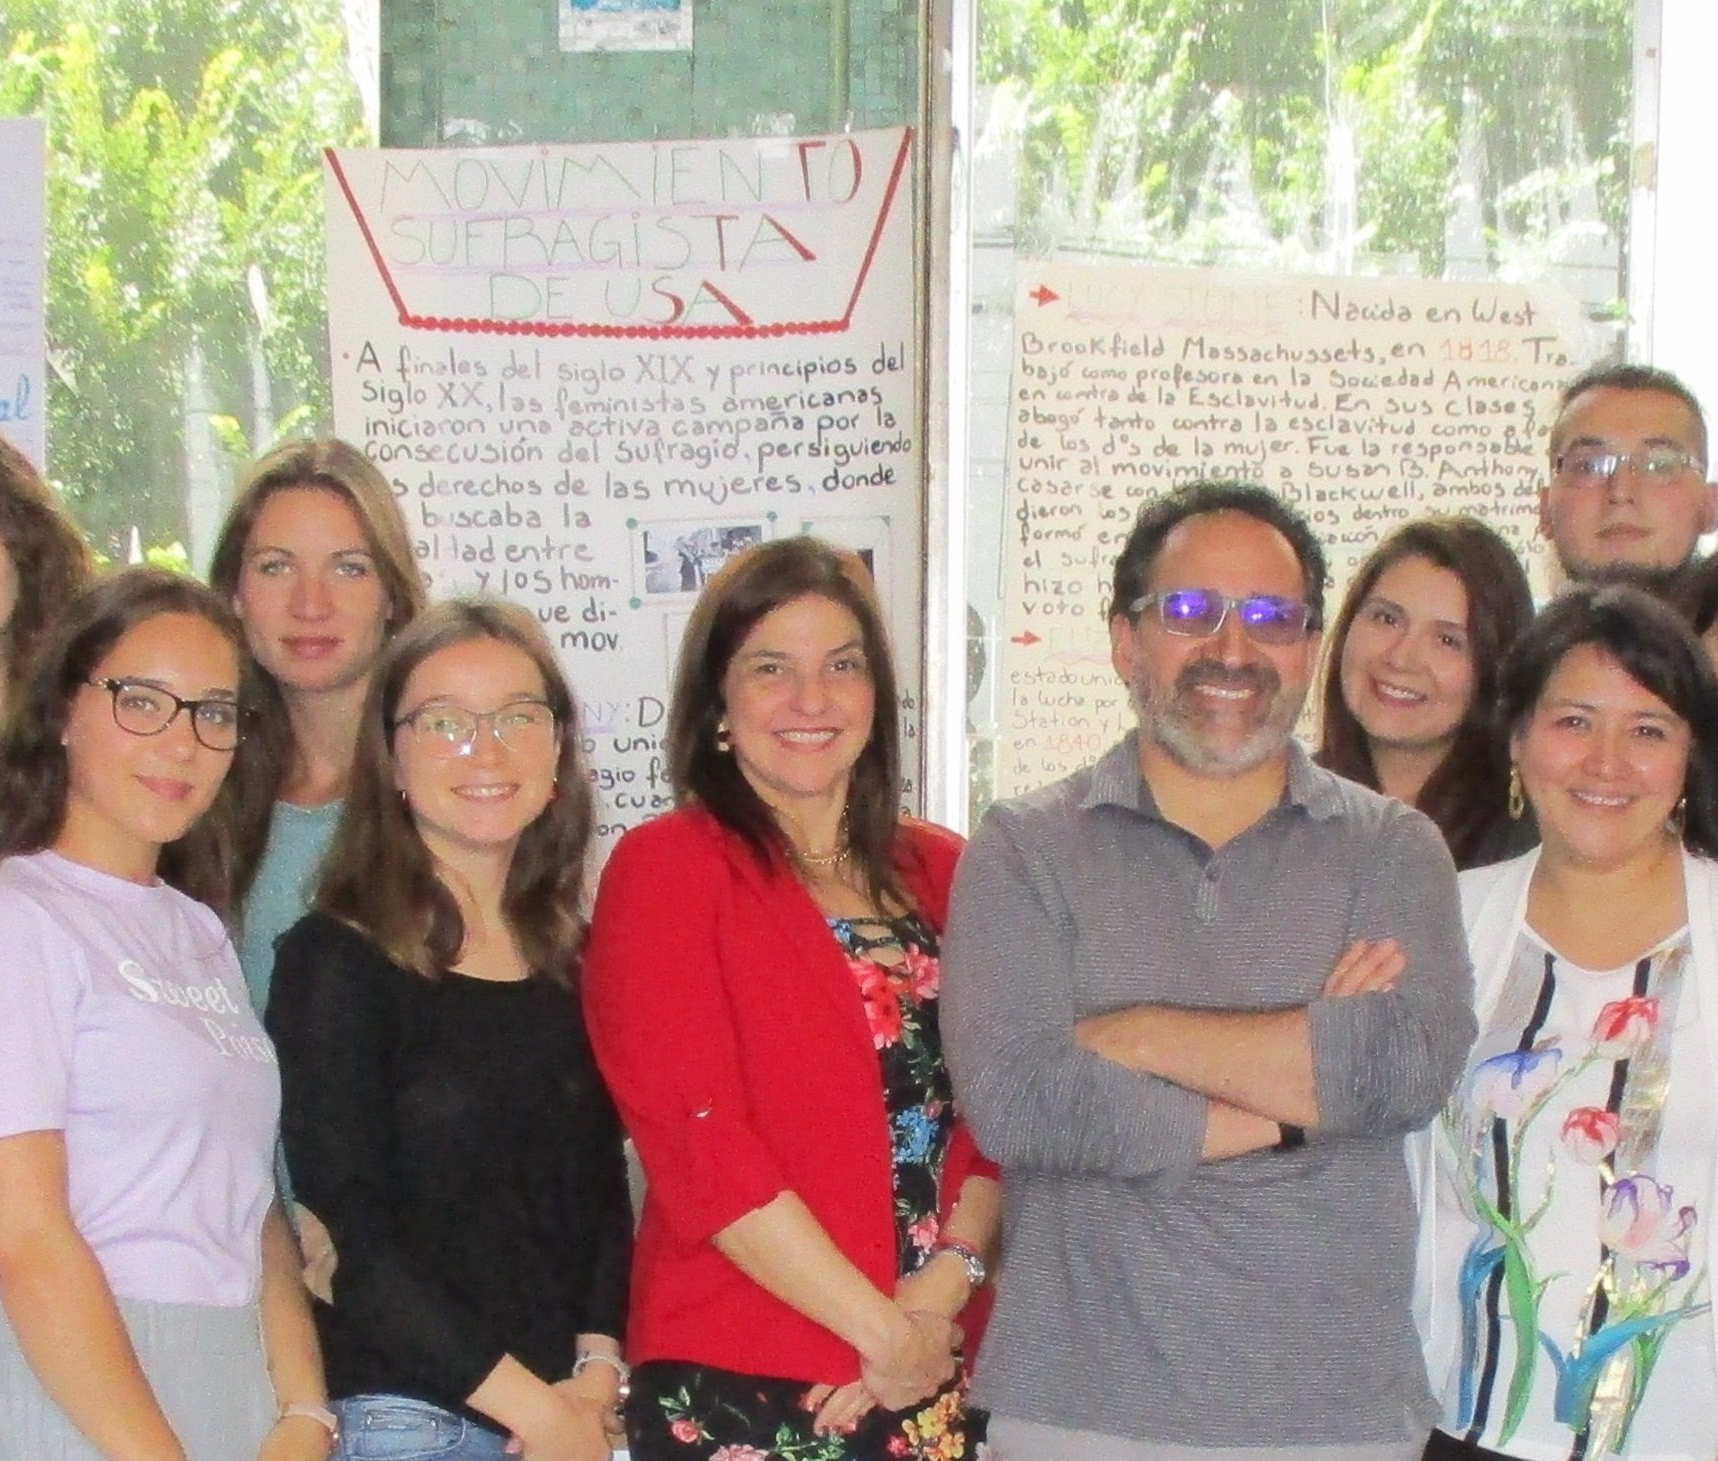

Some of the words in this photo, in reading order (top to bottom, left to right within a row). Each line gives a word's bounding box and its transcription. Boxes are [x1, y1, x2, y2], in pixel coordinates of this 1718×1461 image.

[489, 271, 573, 320] DE
[604, 274, 753, 325] USA
[1310, 289, 1413, 323] Nacida
[1425, 309, 1462, 325] en
[1471, 296, 1539, 327] West
[1390, 340, 1427, 358] en
[356, 339, 382, 374] A
[397, 344, 488, 384] finales
[500, 348, 540, 381] del
[634, 353, 695, 385] XIX
[705, 364, 720, 392] y
[730, 355, 858, 395] principios
[871, 340, 905, 377] del
[1021, 357, 1074, 387] bajó
[1082, 365, 1128, 381] como
[1136, 362, 1244, 389] profesora
[1252, 372, 1279, 387] en
[1291, 366, 1312, 387] la
[498, 382, 543, 413] las
[554, 386, 707, 421] feministas
[721, 386, 884, 413] americanas
[1018, 387, 1046, 401] en
[1056, 384, 1120, 402] contra
[1127, 383, 1149, 404] de
[1158, 385, 1177, 406] la
[1334, 392, 1371, 413] En
[365, 415, 486, 439] iniciaron
[499, 418, 552, 435] una
[567, 414, 662, 440] activa
[671, 410, 805, 447] campaña
[816, 413, 860, 447] por
[876, 405, 898, 429] la
[1017, 407, 1086, 433] abogó
[1094, 408, 1156, 431] tanto
[1171, 412, 1243, 433] contra
[1254, 411, 1278, 434] la
[1288, 412, 1415, 437] esclavitud
[1431, 423, 1492, 437] como
[556, 438, 600, 464] del
[756, 430, 913, 474] persiguiendo
[1017, 430, 1043, 450] de
[1059, 434, 1091, 453] los
[1152, 438, 1180, 458] de
[1193, 434, 1215, 457] la
[1223, 438, 1301, 463] mujer.
[1307, 435, 1352, 457] Fue
[1361, 439, 1381, 457] la
[1391, 437, 1535, 463] responsable
[418, 471, 543, 498] derechos
[553, 469, 591, 497] de
[604, 471, 652, 500] las
[821, 462, 897, 493] donde
[1018, 454, 1070, 473] unir
[1078, 455, 1100, 476] al
[1111, 457, 1265, 480] movimiento
[1279, 467, 1294, 480] a
[1125, 487, 1159, 499] con
[1432, 480, 1506, 499] ambos
[420, 500, 543, 529] buscaba
[562, 502, 592, 529] la
[1016, 497, 1083, 522] dieron
[1352, 505, 1410, 521] dentro
[1018, 520, 1088, 548] formó
[504, 535, 595, 563] entre
[1022, 548, 1042, 569] el
[502, 569, 552, 594] los
[1023, 572, 1084, 597] hizo
[538, 606, 571, 624] ue
[1021, 599, 1086, 618] voto
[1011, 687, 1030, 708] la
[1037, 690, 1087, 708] lucha
[1011, 711, 1092, 730] Station
[1098, 718, 1111, 734] y
[1013, 736, 1038, 751] en
[1042, 733, 1103, 756] 1840
[1013, 757, 1033, 775] de
[1041, 757, 1069, 773] los
[117, 959, 240, 1015] Sweet
